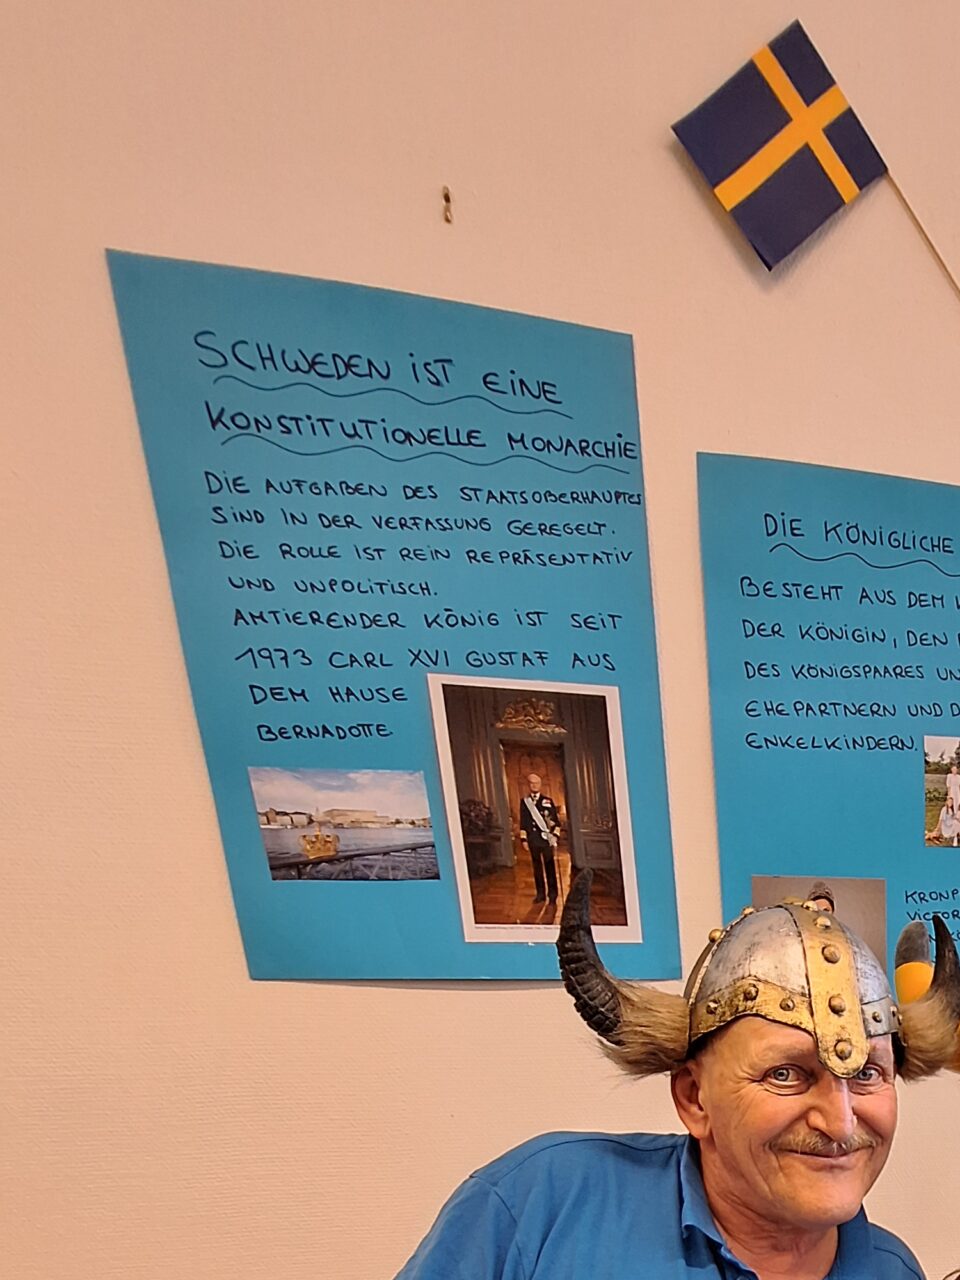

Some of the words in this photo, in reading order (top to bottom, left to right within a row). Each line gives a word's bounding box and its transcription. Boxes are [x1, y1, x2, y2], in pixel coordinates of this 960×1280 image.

[194, 331, 390, 380] SCHWEDEN
[266, 478, 387, 496] AUFGABEN
[403, 485, 438, 500] DES
[280, 508, 307, 525] IN
[318, 513, 362, 529] DER
[371, 515, 491, 531] VERFASSUNG
[279, 543, 341, 559] ROLLE
[228, 577, 275, 591] UND
[740, 576, 843, 600] BESTEHT
[859, 587, 896, 605] AUS
[908, 591, 944, 608] DEM
[742, 619, 785, 638] DER
[907, 630, 948, 647] DEN
[235, 648, 312, 669] 1973
[329, 652, 393, 668] CARL
[408, 648, 449, 667] XVI
[466, 651, 548, 668] GUSTAF
[572, 653, 616, 671] AUS
[744, 661, 780, 679] DES
[248, 685, 309, 705] DEM
[328, 686, 408, 703] HAUSE
[745, 700, 896, 717] EHEPARTNERN
[907, 703, 943, 717] UND
